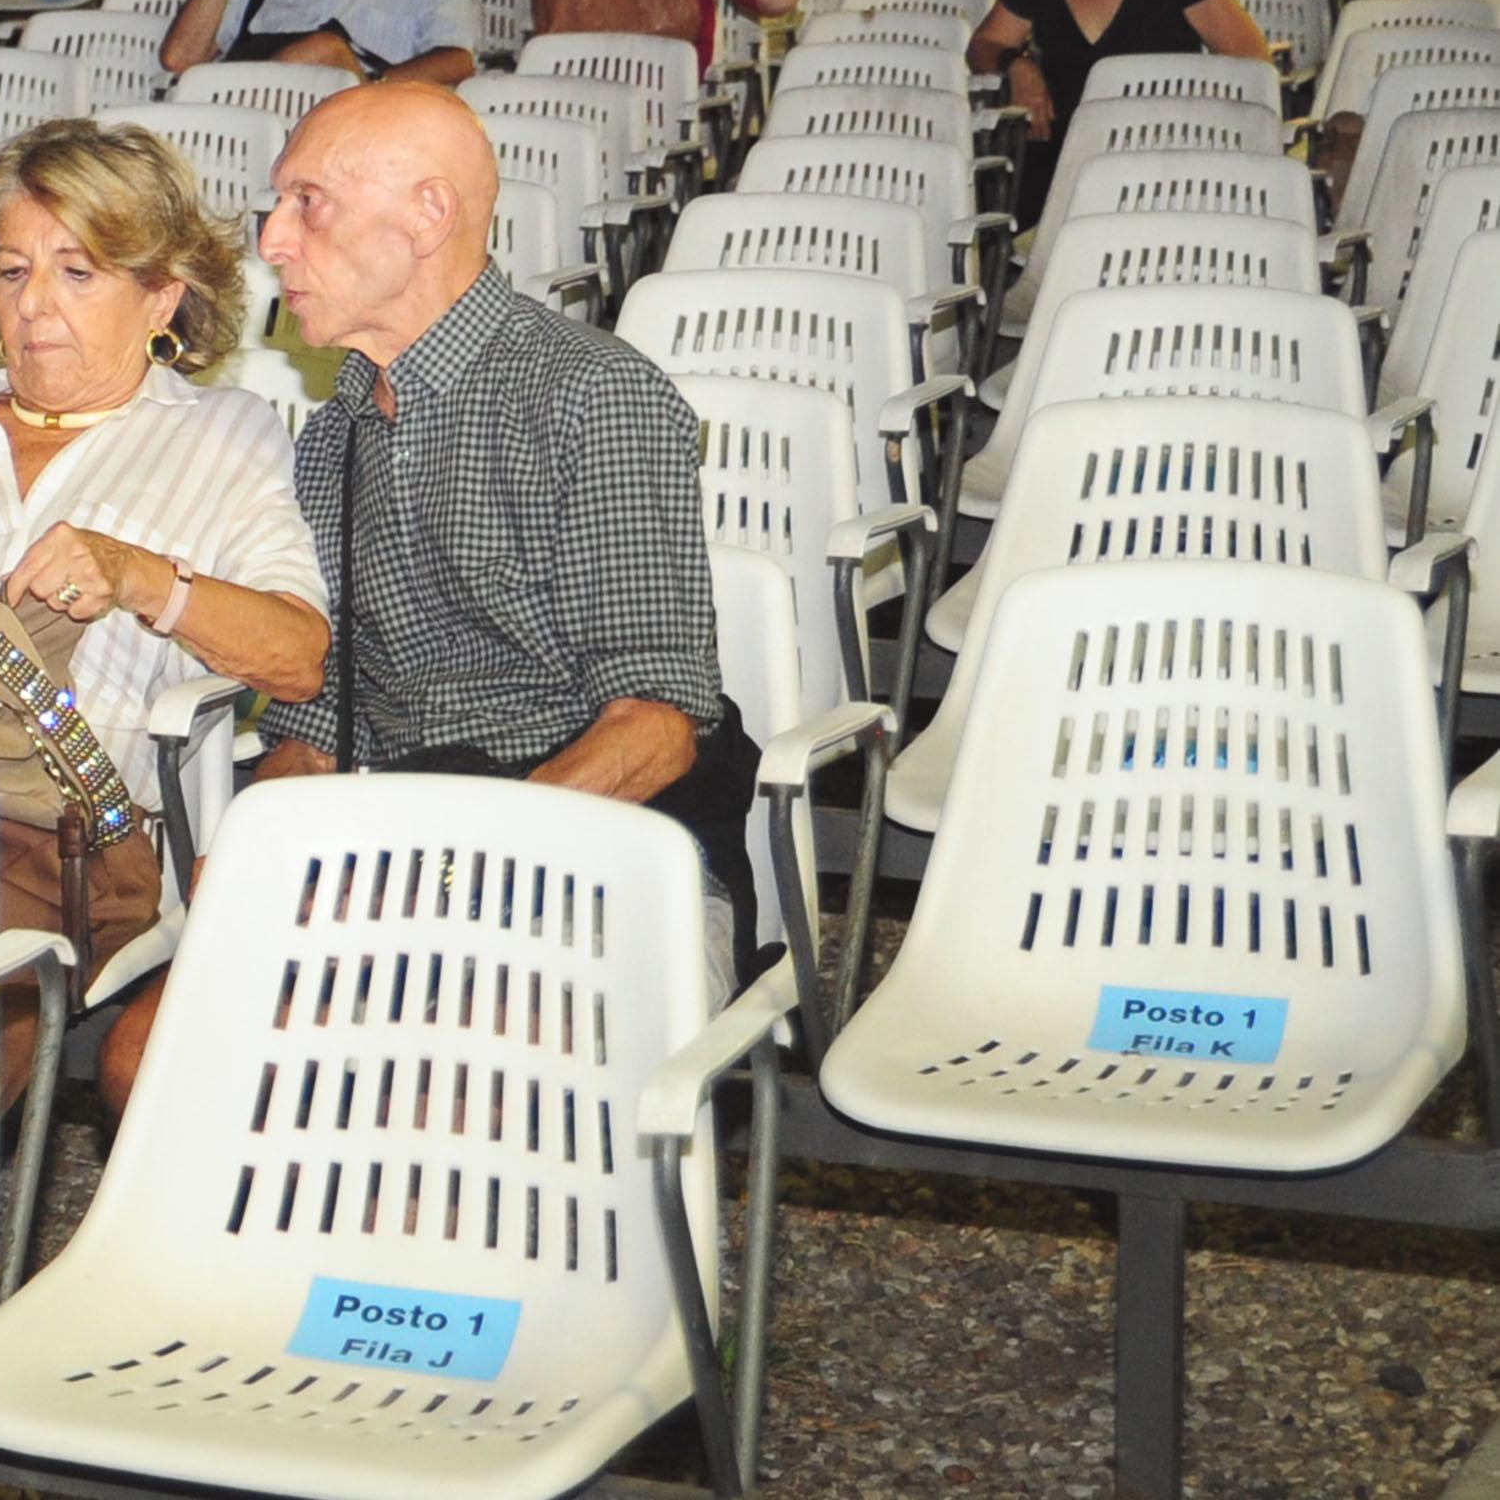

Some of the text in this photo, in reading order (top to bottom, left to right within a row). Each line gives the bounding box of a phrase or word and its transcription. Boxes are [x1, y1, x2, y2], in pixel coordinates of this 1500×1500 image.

[1123, 1000, 1257, 1029] Posto 1
[1131, 1034, 1234, 1057] Fila K
[333, 1295, 485, 1336] Posto 1
[340, 1338, 453, 1369] Fila J
